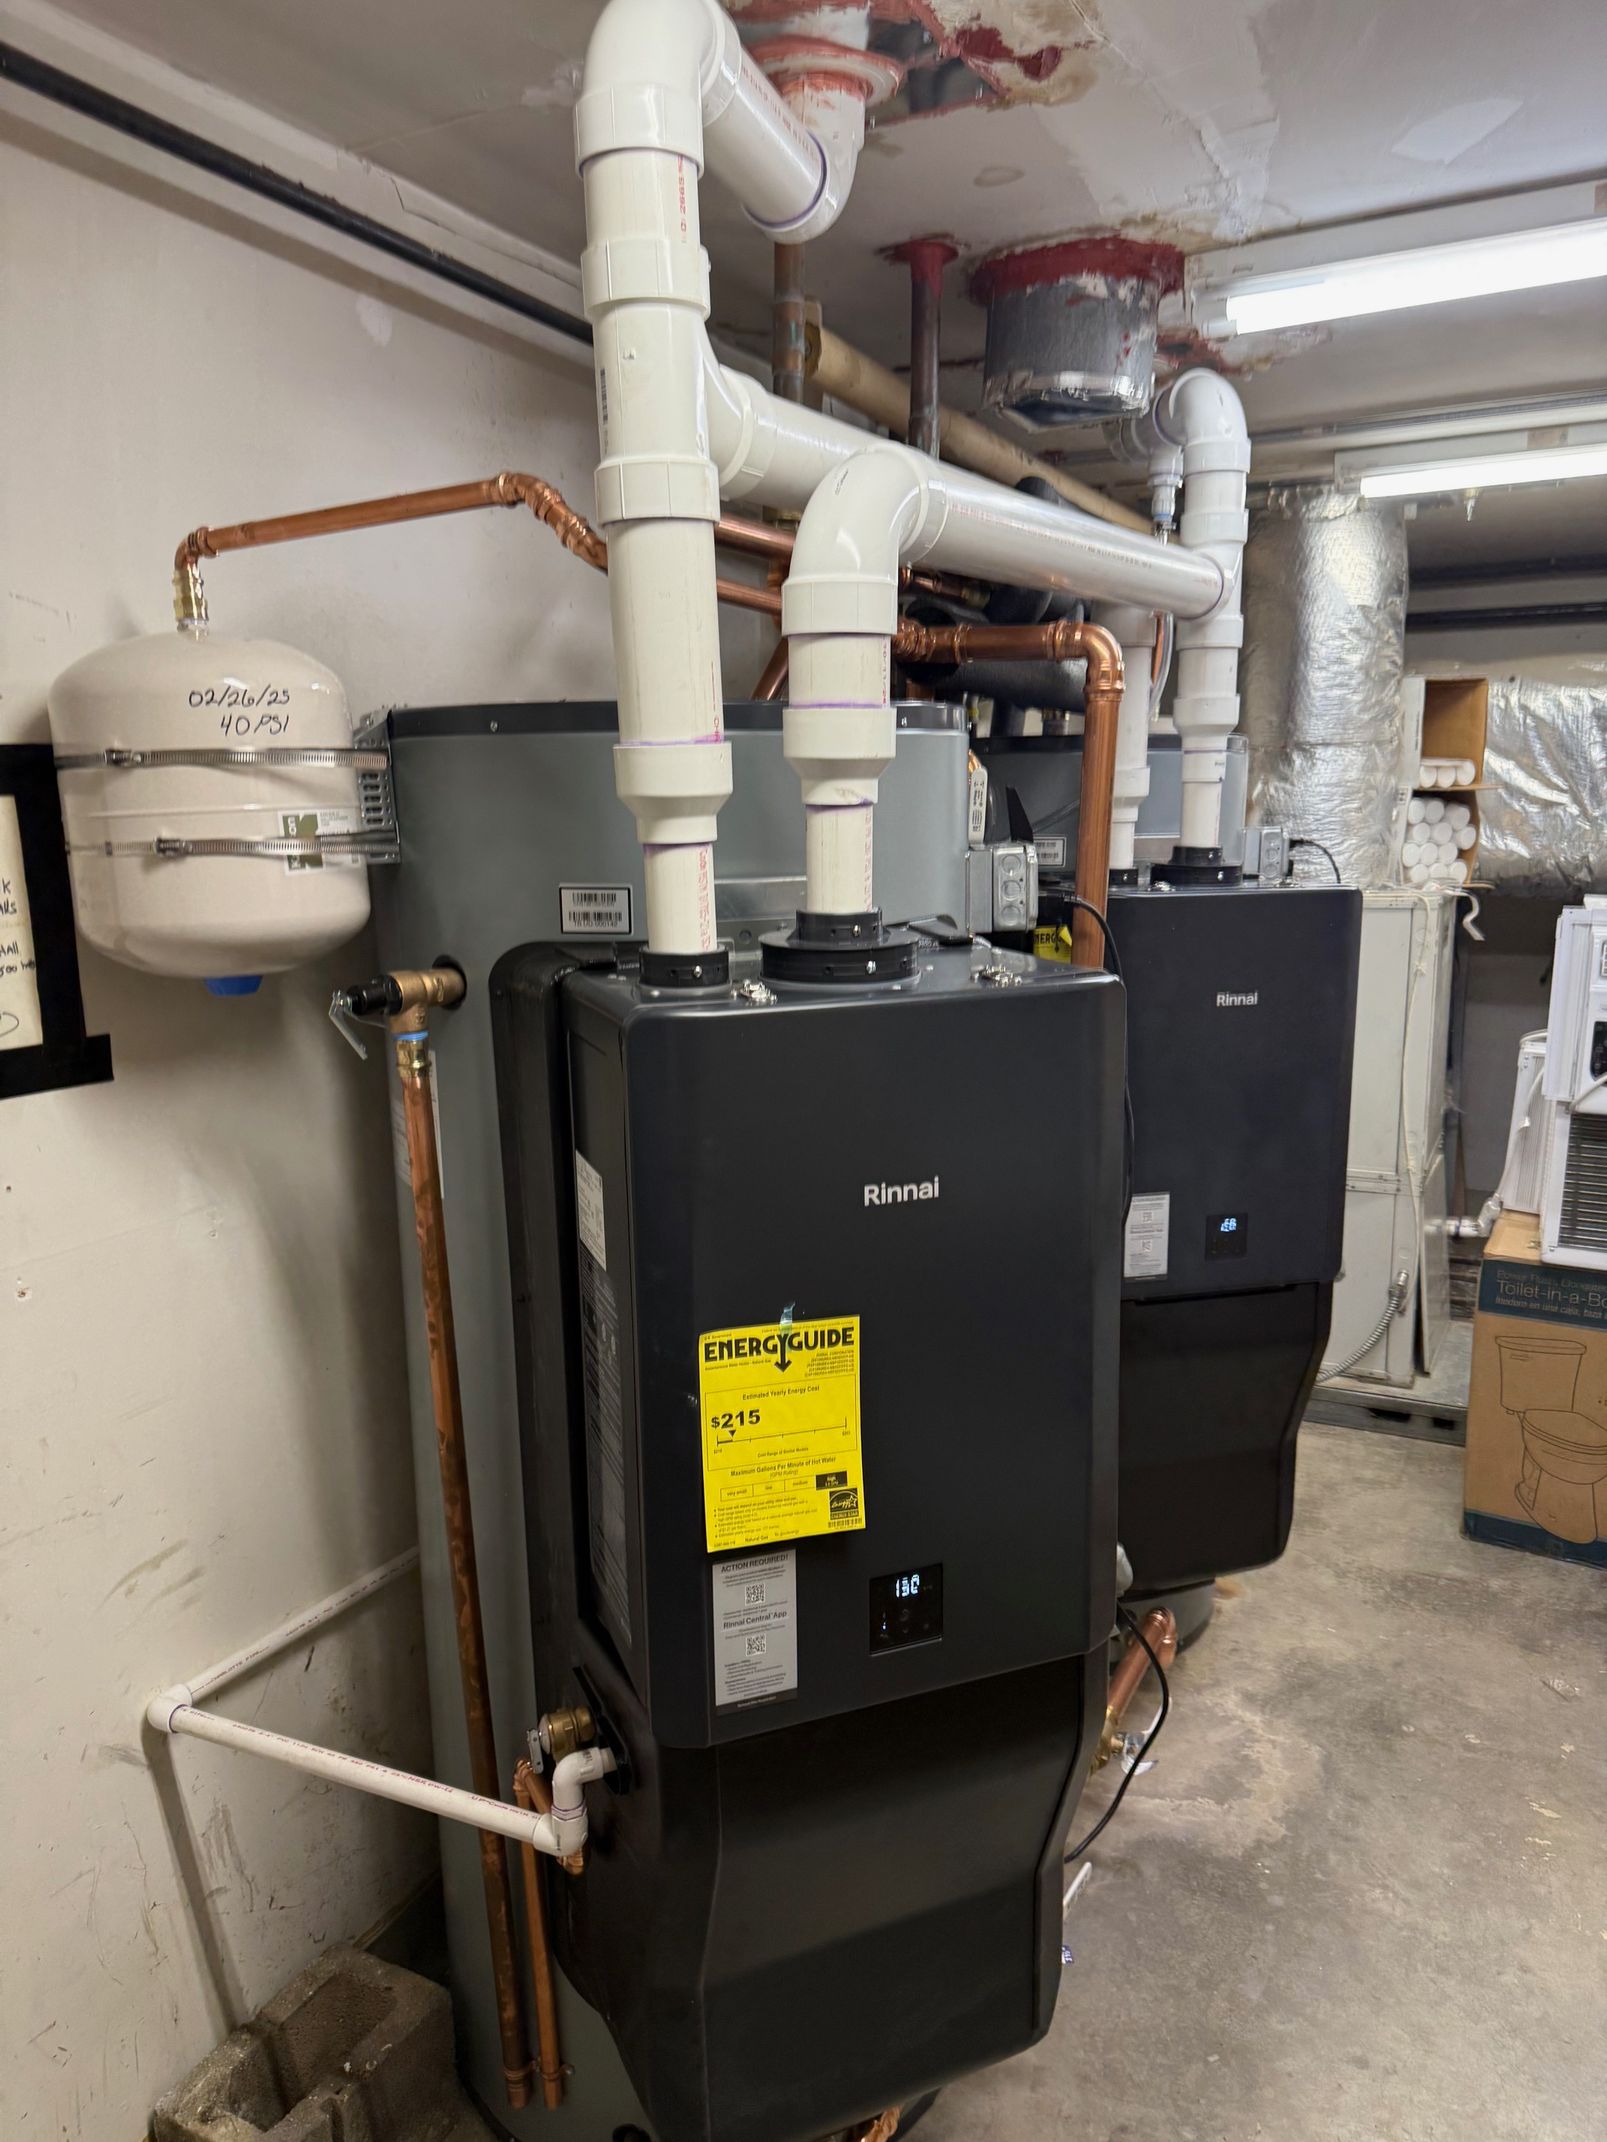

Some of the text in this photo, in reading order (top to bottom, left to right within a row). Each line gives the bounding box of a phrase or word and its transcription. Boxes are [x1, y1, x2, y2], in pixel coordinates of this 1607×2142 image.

[189, 684, 290, 708] 02/26/25
[221, 713, 290, 736] 40 PSI
[1216, 990, 1258, 1007] Rinnai
[864, 1175, 940, 1207] Rinnai
[742, 1385, 820, 1400] Estimated Yearly Energy Cost
[711, 1409, 761, 1430] $215
[730, 1468, 756, 1476] Maximum
[756, 1465, 777, 1473] Gallons
[822, 1456, 836, 1464] Water
[721, 1554, 789, 1573] ACTION REQUIRED!
[723, 1618, 745, 1629] Rinnai
